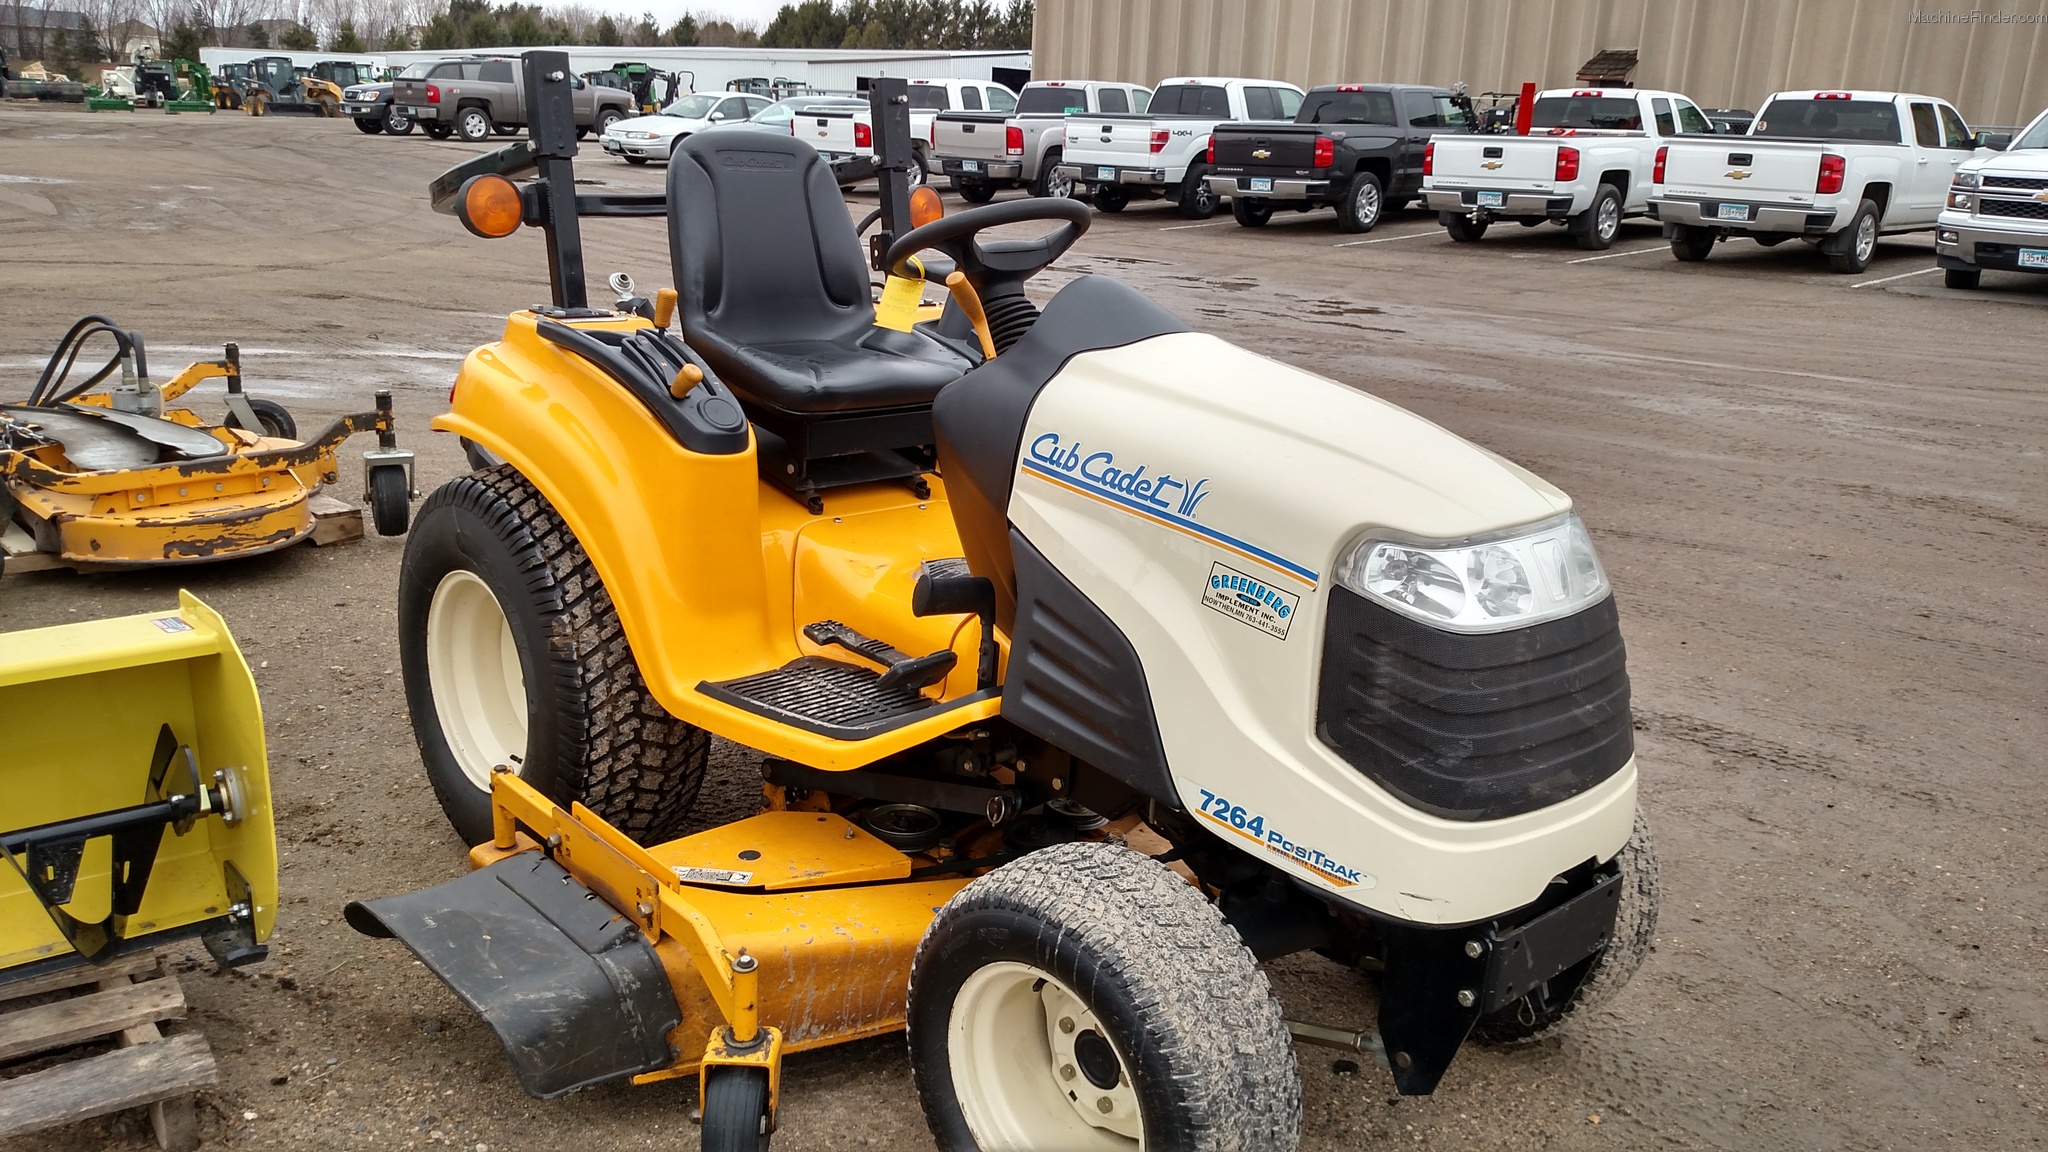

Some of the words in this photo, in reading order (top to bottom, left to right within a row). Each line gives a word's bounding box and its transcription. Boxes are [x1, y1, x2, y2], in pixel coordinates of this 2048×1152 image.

[1030, 433, 1080, 472] Cub
[1080, 452, 1184, 508] Cadet
[1211, 574, 1292, 619] GREENBERG
[1215, 592, 1260, 615] IMPLEMENT
[1260, 611, 1276, 624] INC.
[1245, 612, 1286, 636] 763-441-3555
[1199, 788, 1264, 838] 7264
